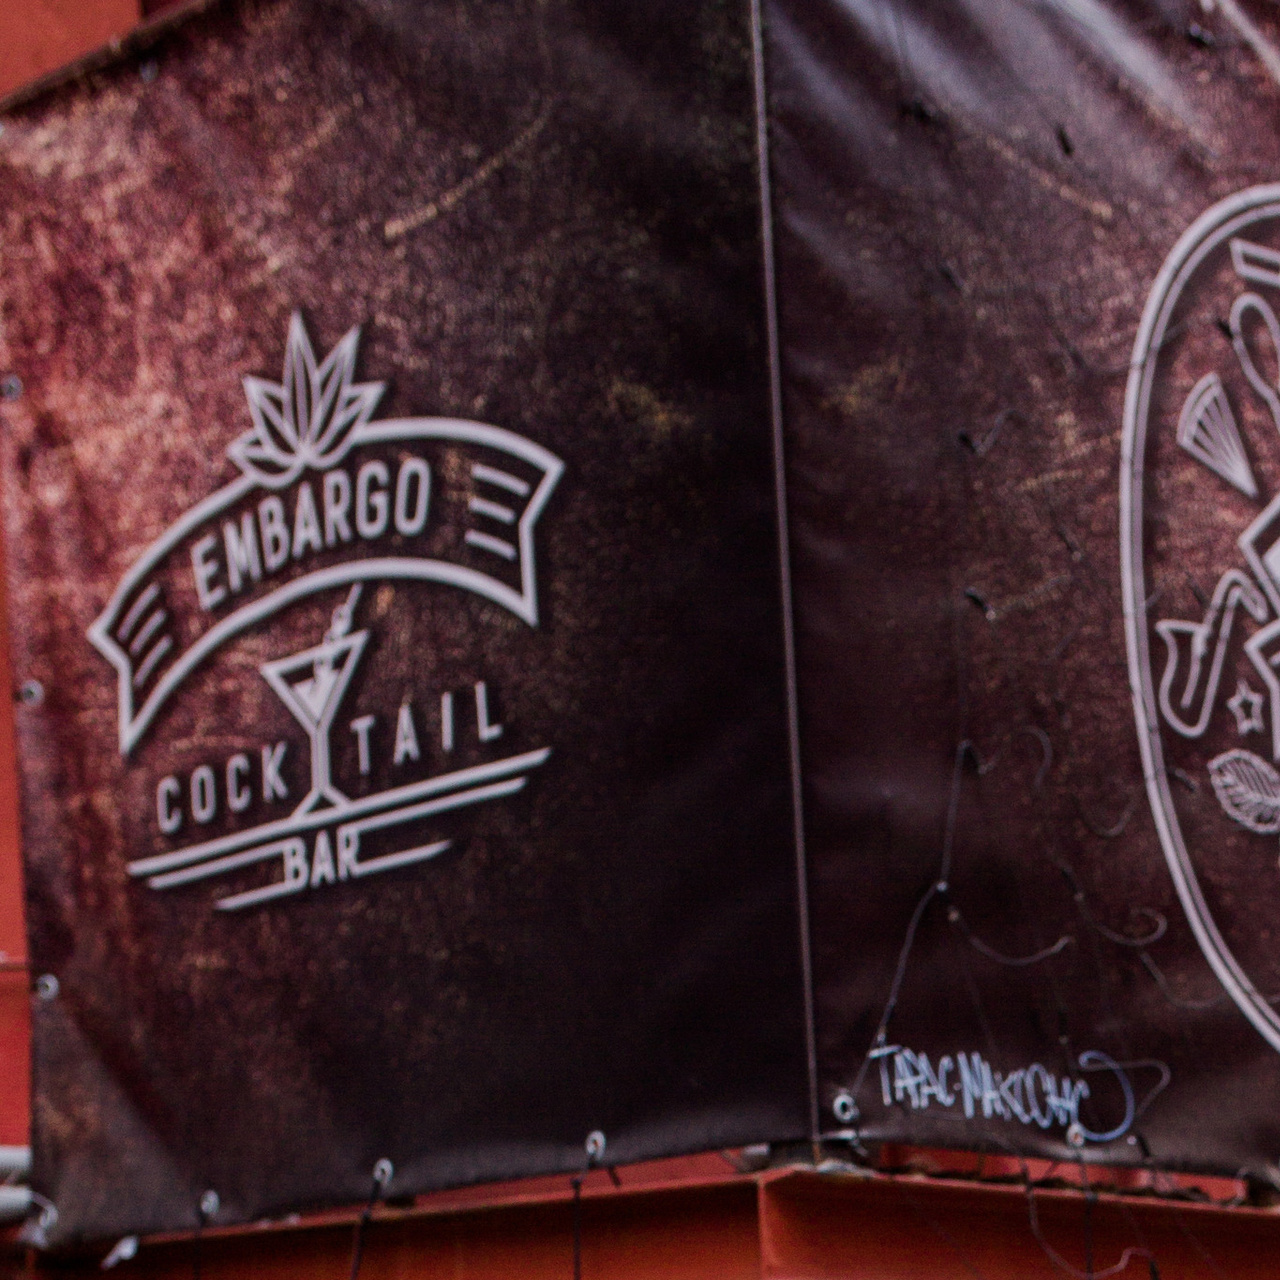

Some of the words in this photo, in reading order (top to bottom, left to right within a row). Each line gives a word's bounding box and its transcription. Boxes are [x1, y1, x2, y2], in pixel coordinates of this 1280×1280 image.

[190, 457, 431, 611] EMBARGO
[156, 741, 289, 833] COCK
[350, 681, 503, 775] TAIL
[283, 823, 361, 889] BAR
